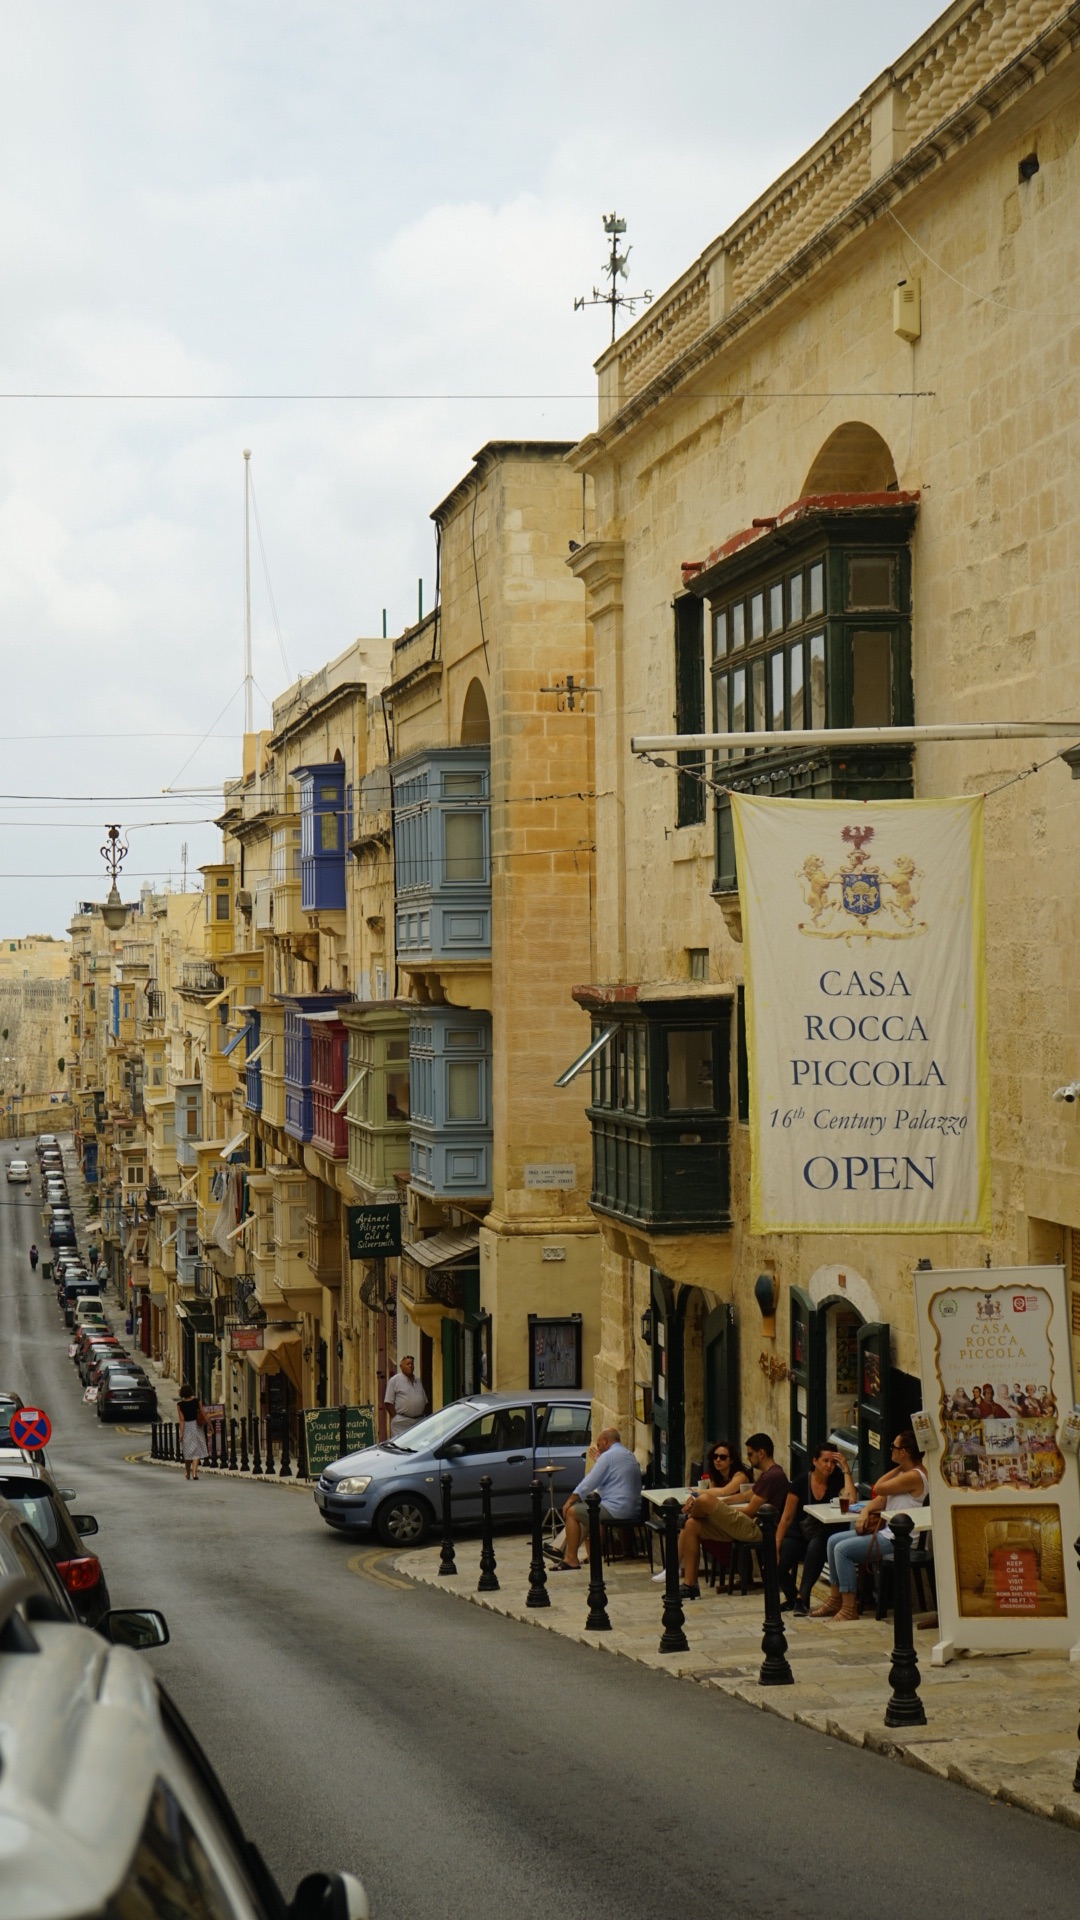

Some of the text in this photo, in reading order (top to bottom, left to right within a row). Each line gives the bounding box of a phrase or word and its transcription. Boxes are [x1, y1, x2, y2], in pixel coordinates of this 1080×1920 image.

[820, 970, 912, 996] CASA
[804, 1014, 929, 1042] ROCCA
[790, 1059, 946, 1087] PICCOLA
[770, 1106, 968, 1136] 16th Century Palazzo
[803, 1156, 936, 1190] OPEN
[357, 1238, 394, 1248] Silversmith
[971, 1324, 1011, 1334] CASA
[966, 1336, 1017, 1347] ROCCA
[960, 1348, 1026, 1359] PICCOLA
[310, 1422, 327, 1432] You
[315, 1432, 333, 1441] Gold
